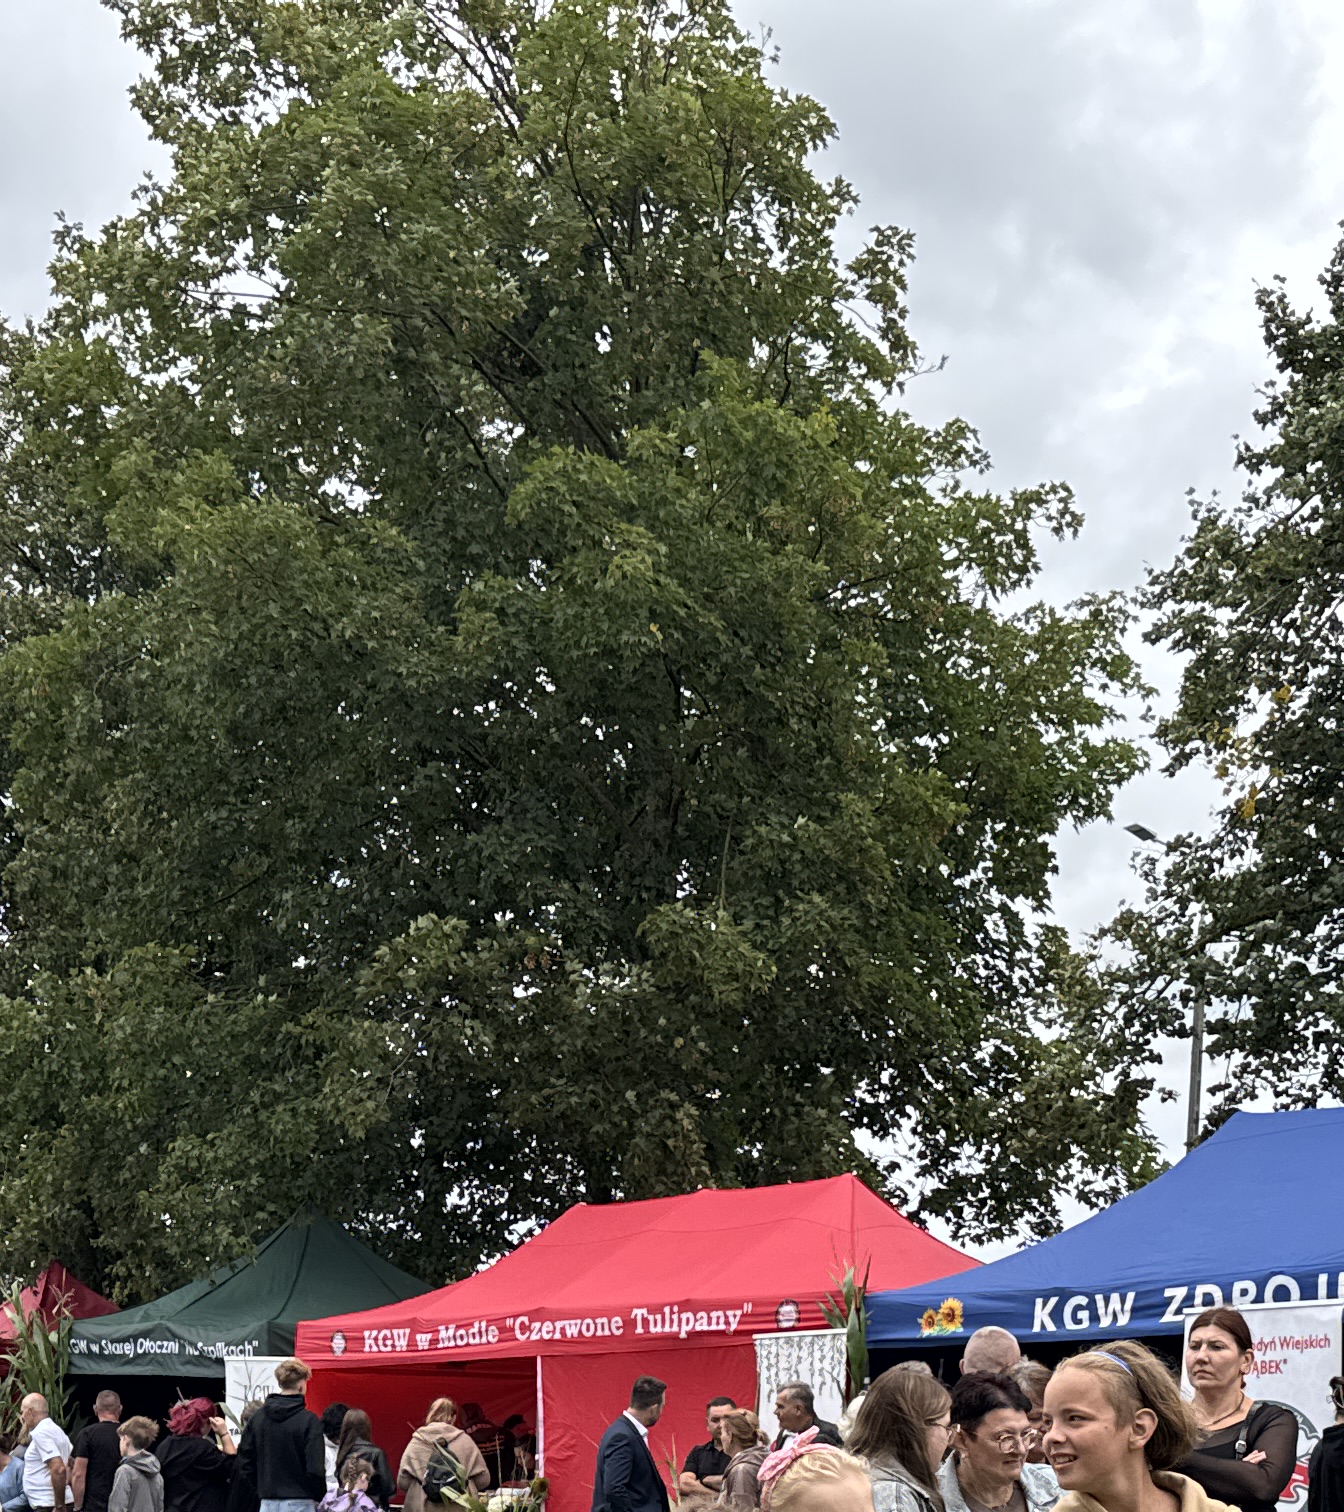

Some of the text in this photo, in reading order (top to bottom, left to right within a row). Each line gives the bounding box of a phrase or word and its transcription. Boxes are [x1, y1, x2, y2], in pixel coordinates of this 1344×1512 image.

[363, 1328, 411, 1353] KGW
[415, 1333, 433, 1351] w
[437, 1320, 500, 1349] Modle
[505, 1316, 624, 1342] "Czerwone
[630, 1302, 753, 1339] Tulipany"
[1032, 1291, 1136, 1333] KGW
[68, 1338, 89, 1354] GW
[1252, 1333, 1331, 1356] odyń Wiejskich
